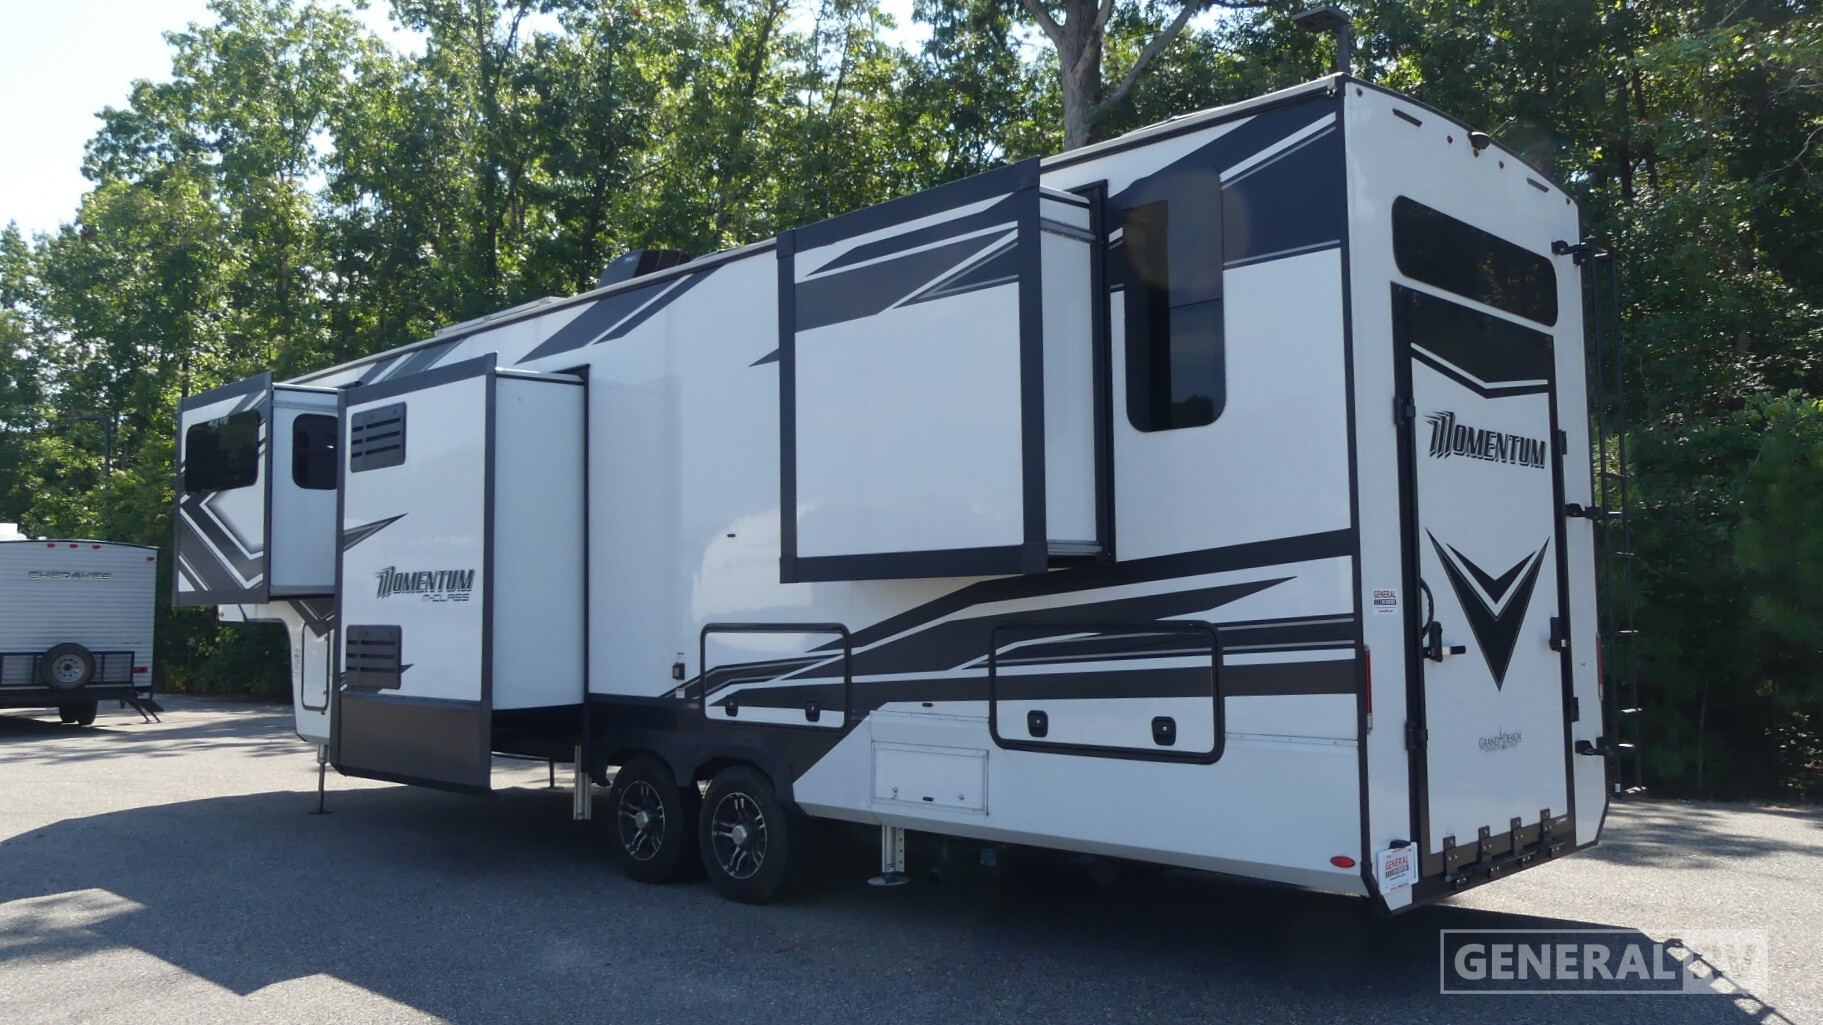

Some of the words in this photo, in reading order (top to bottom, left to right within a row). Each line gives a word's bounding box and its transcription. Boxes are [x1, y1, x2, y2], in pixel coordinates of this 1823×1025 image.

[1424, 410, 1546, 469] MOMENTUM
[374, 566, 475, 599] MOMENTUM
[1373, 590, 1396, 599] GENERAL
[1385, 855, 1409, 870] GENERAL
